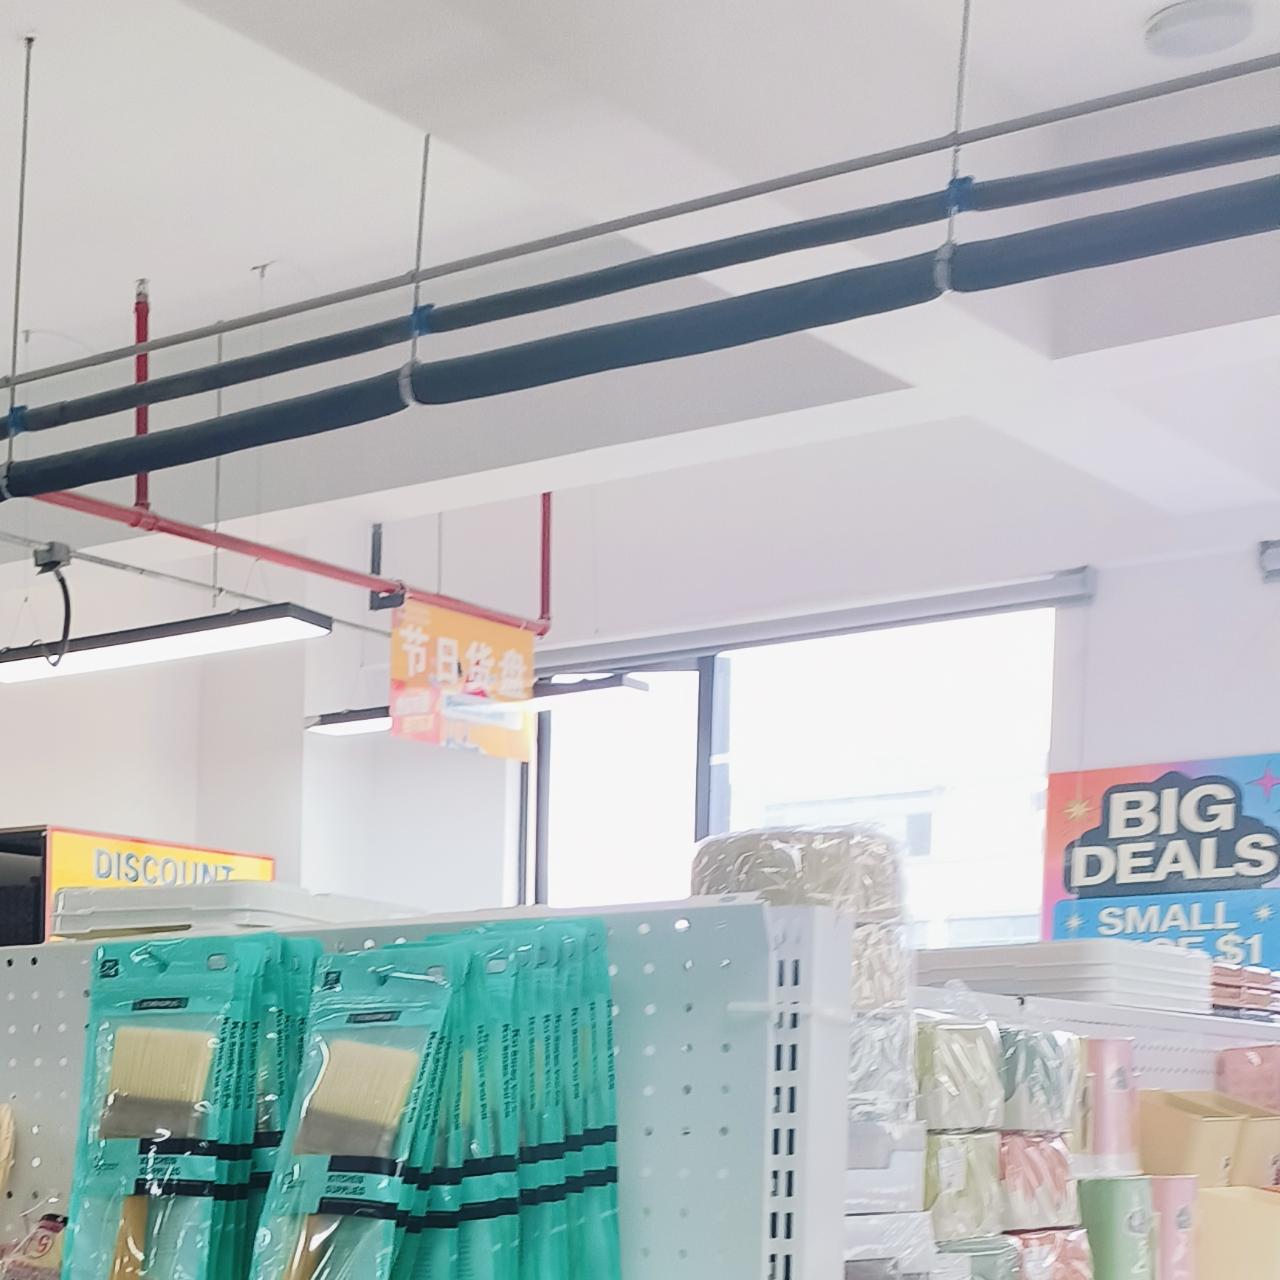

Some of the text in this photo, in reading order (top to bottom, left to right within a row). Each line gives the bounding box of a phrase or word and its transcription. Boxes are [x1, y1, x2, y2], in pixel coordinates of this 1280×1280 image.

[1107, 782, 1236, 839] BIG
[92, 847, 235, 885] DISCOUNT
[1070, 833, 1279, 888] DEALS
[1097, 901, 1240, 935] SMALL
